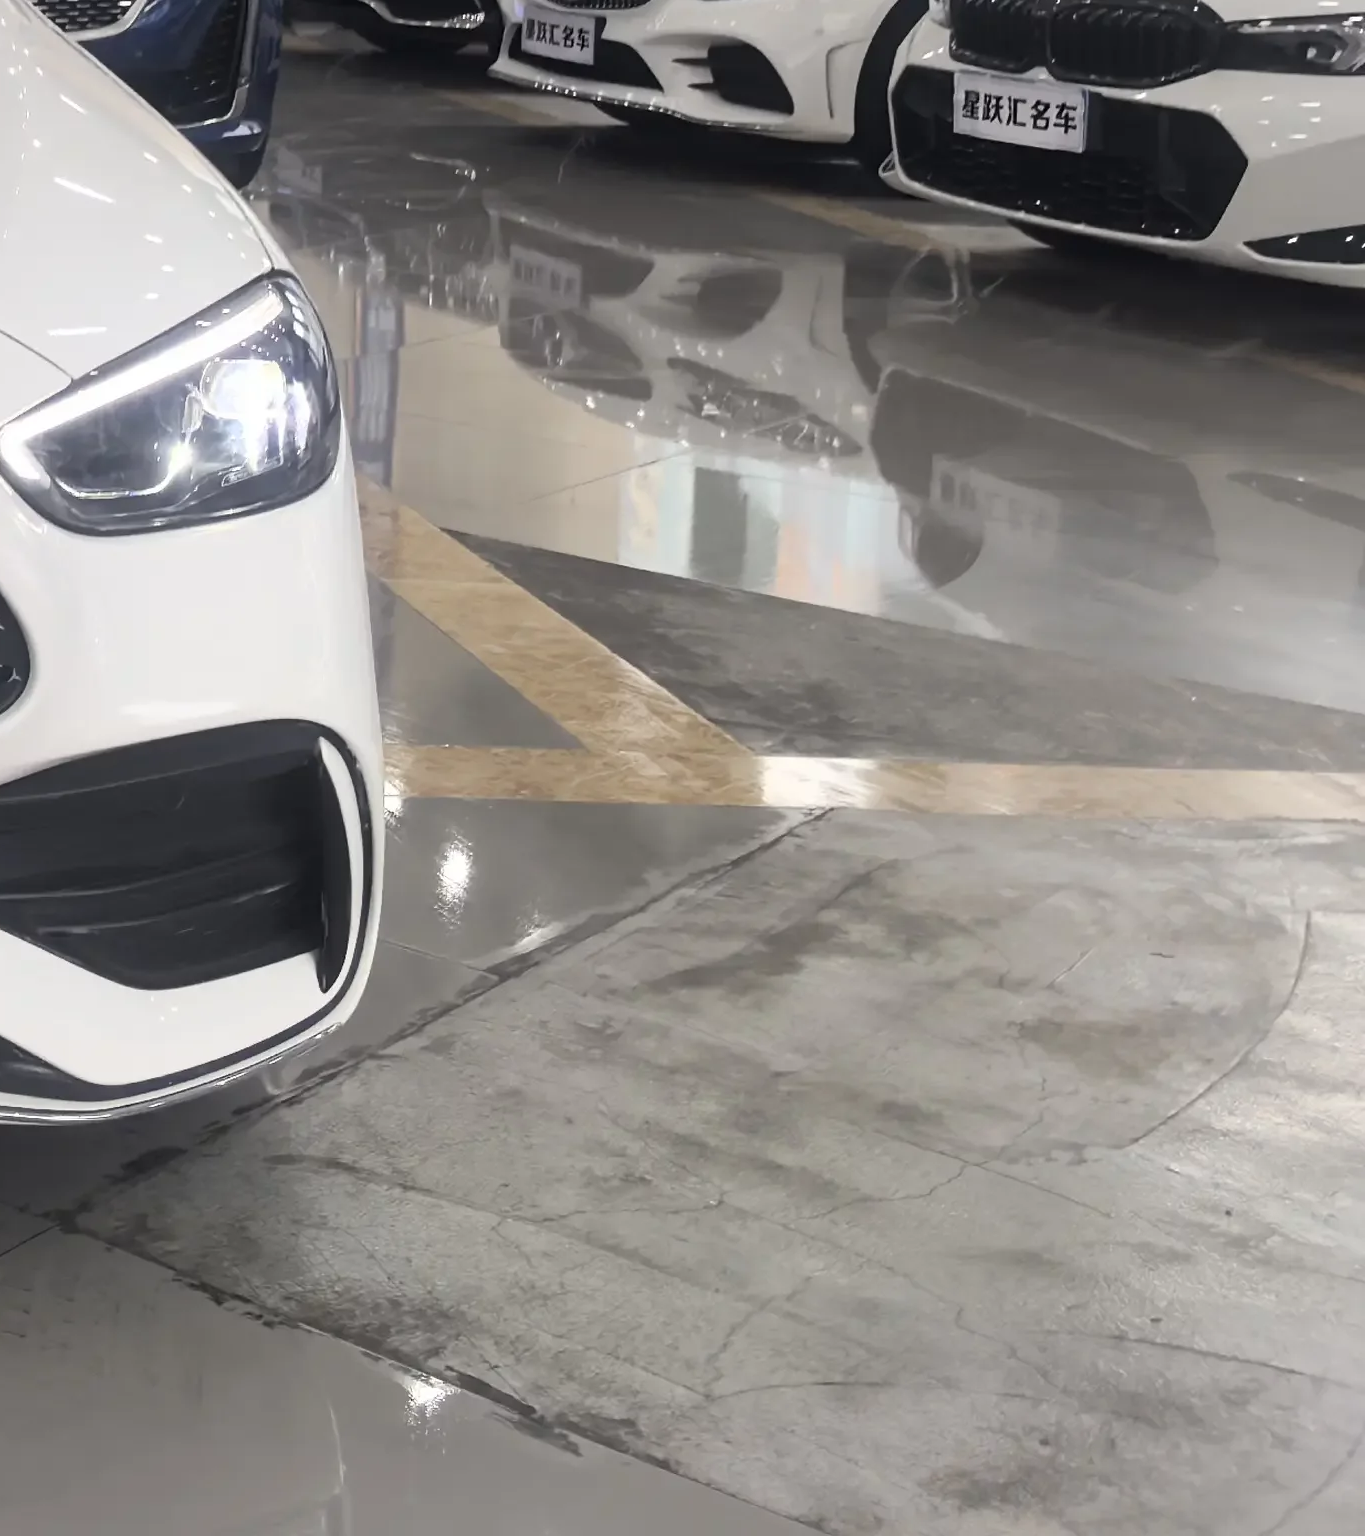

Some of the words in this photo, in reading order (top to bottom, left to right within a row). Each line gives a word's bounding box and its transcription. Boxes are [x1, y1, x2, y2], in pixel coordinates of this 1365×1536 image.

[961, 89, 1078, 135] 星跃汇名车
